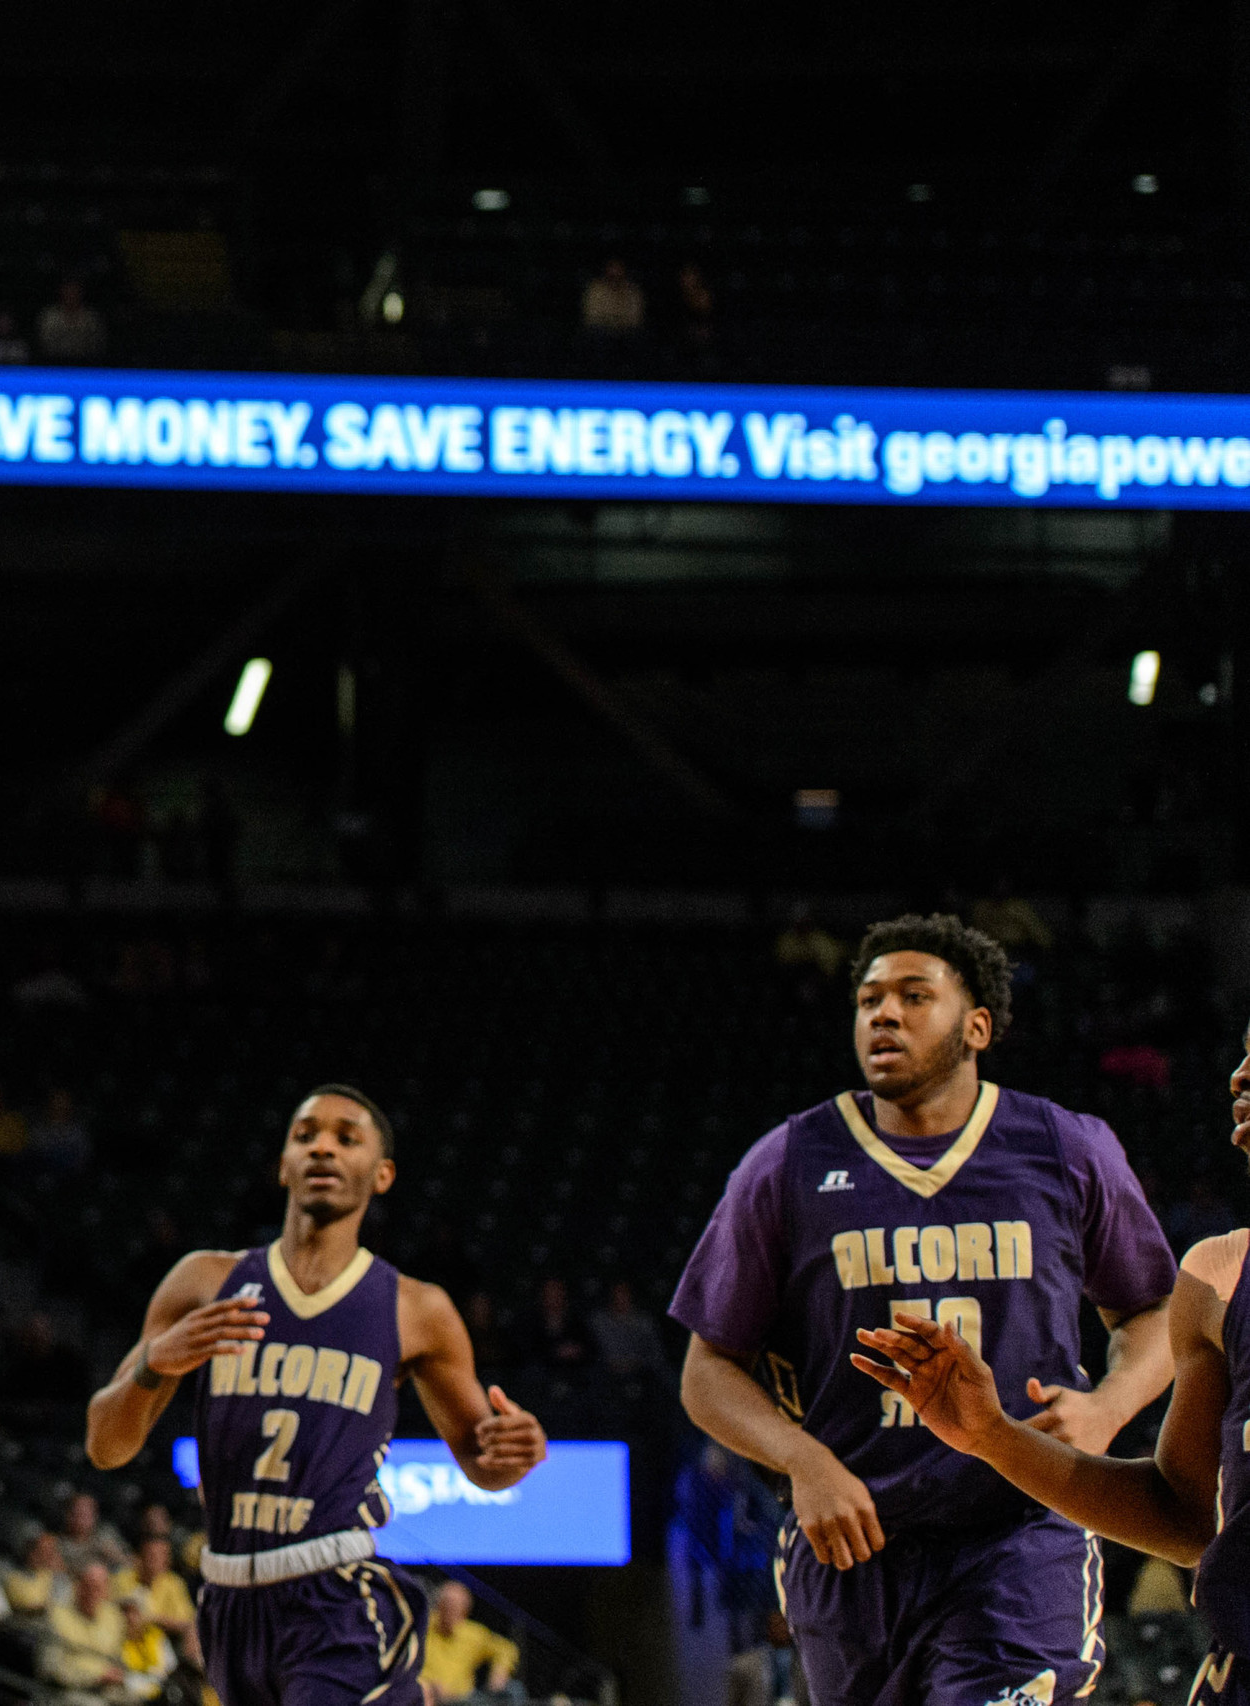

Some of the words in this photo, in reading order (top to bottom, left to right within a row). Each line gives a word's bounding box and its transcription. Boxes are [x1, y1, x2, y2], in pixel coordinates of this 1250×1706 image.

[79, 396, 319, 470] MONEY.
[322, 401, 485, 474] SAVE
[490, 405, 740, 478] ENERGY.
[742, 411, 878, 482] Visit
[832, 1220, 1033, 1290] ALCORN
[209, 1338, 384, 1416] ALCORN
[253, 1409, 300, 1482] 2
